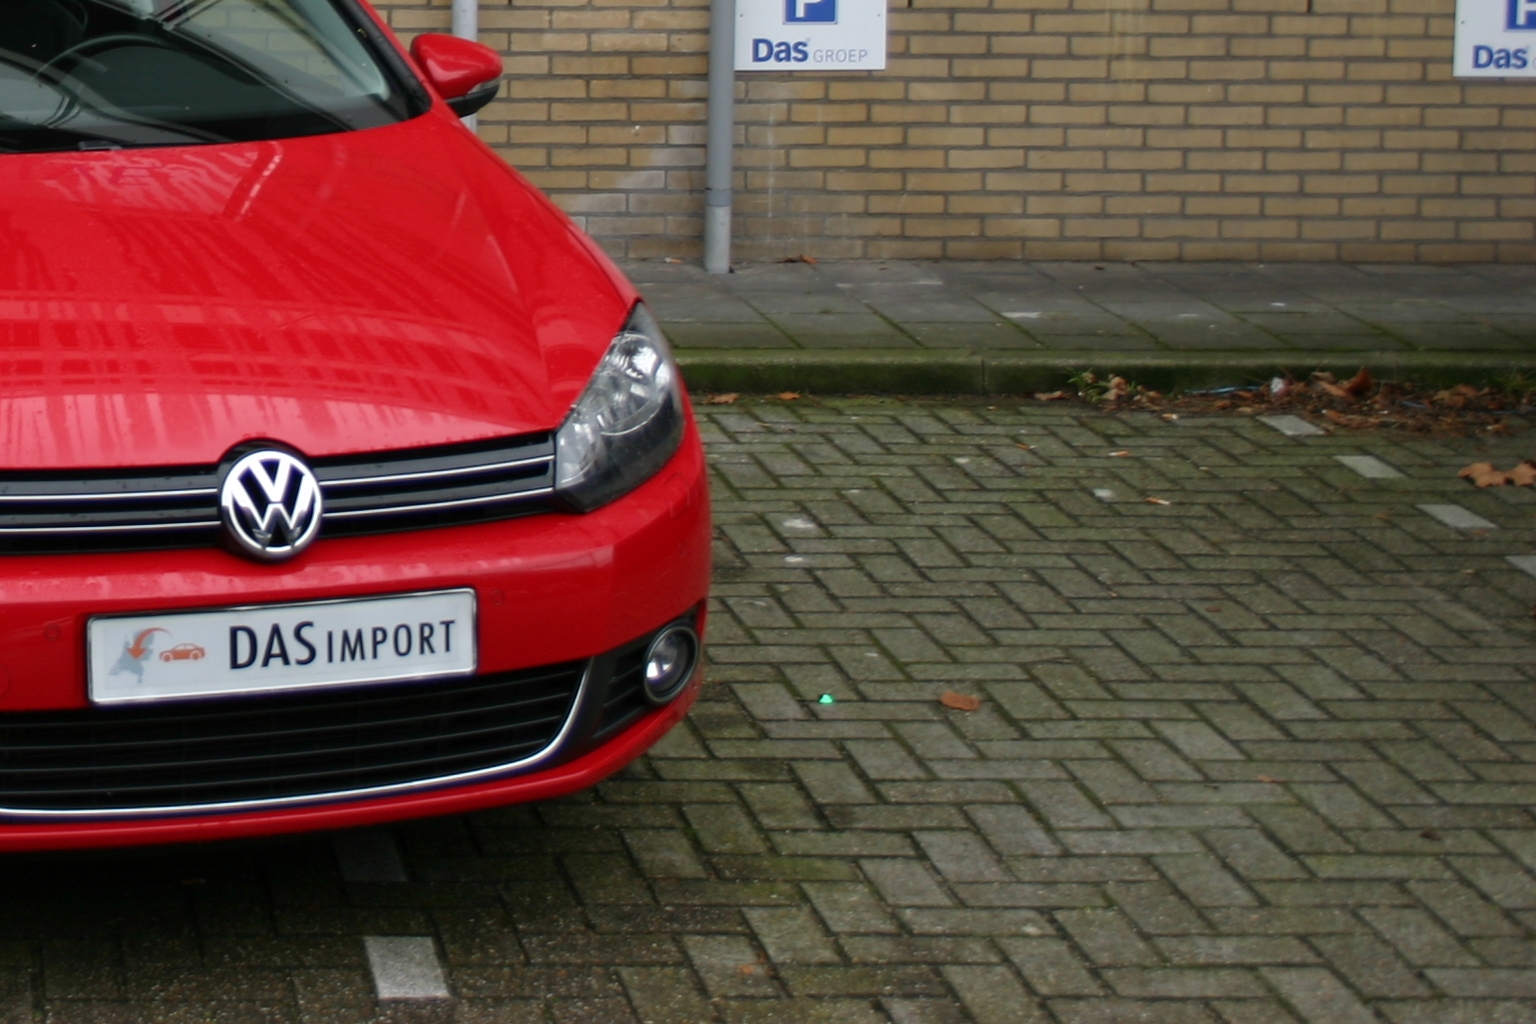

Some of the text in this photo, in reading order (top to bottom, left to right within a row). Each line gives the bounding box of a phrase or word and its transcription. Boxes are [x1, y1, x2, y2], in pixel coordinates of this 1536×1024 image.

[813, 49, 868, 63] GROEP
[1472, 45, 1528, 69] Das
[228, 619, 456, 670] DAS IMPORT
